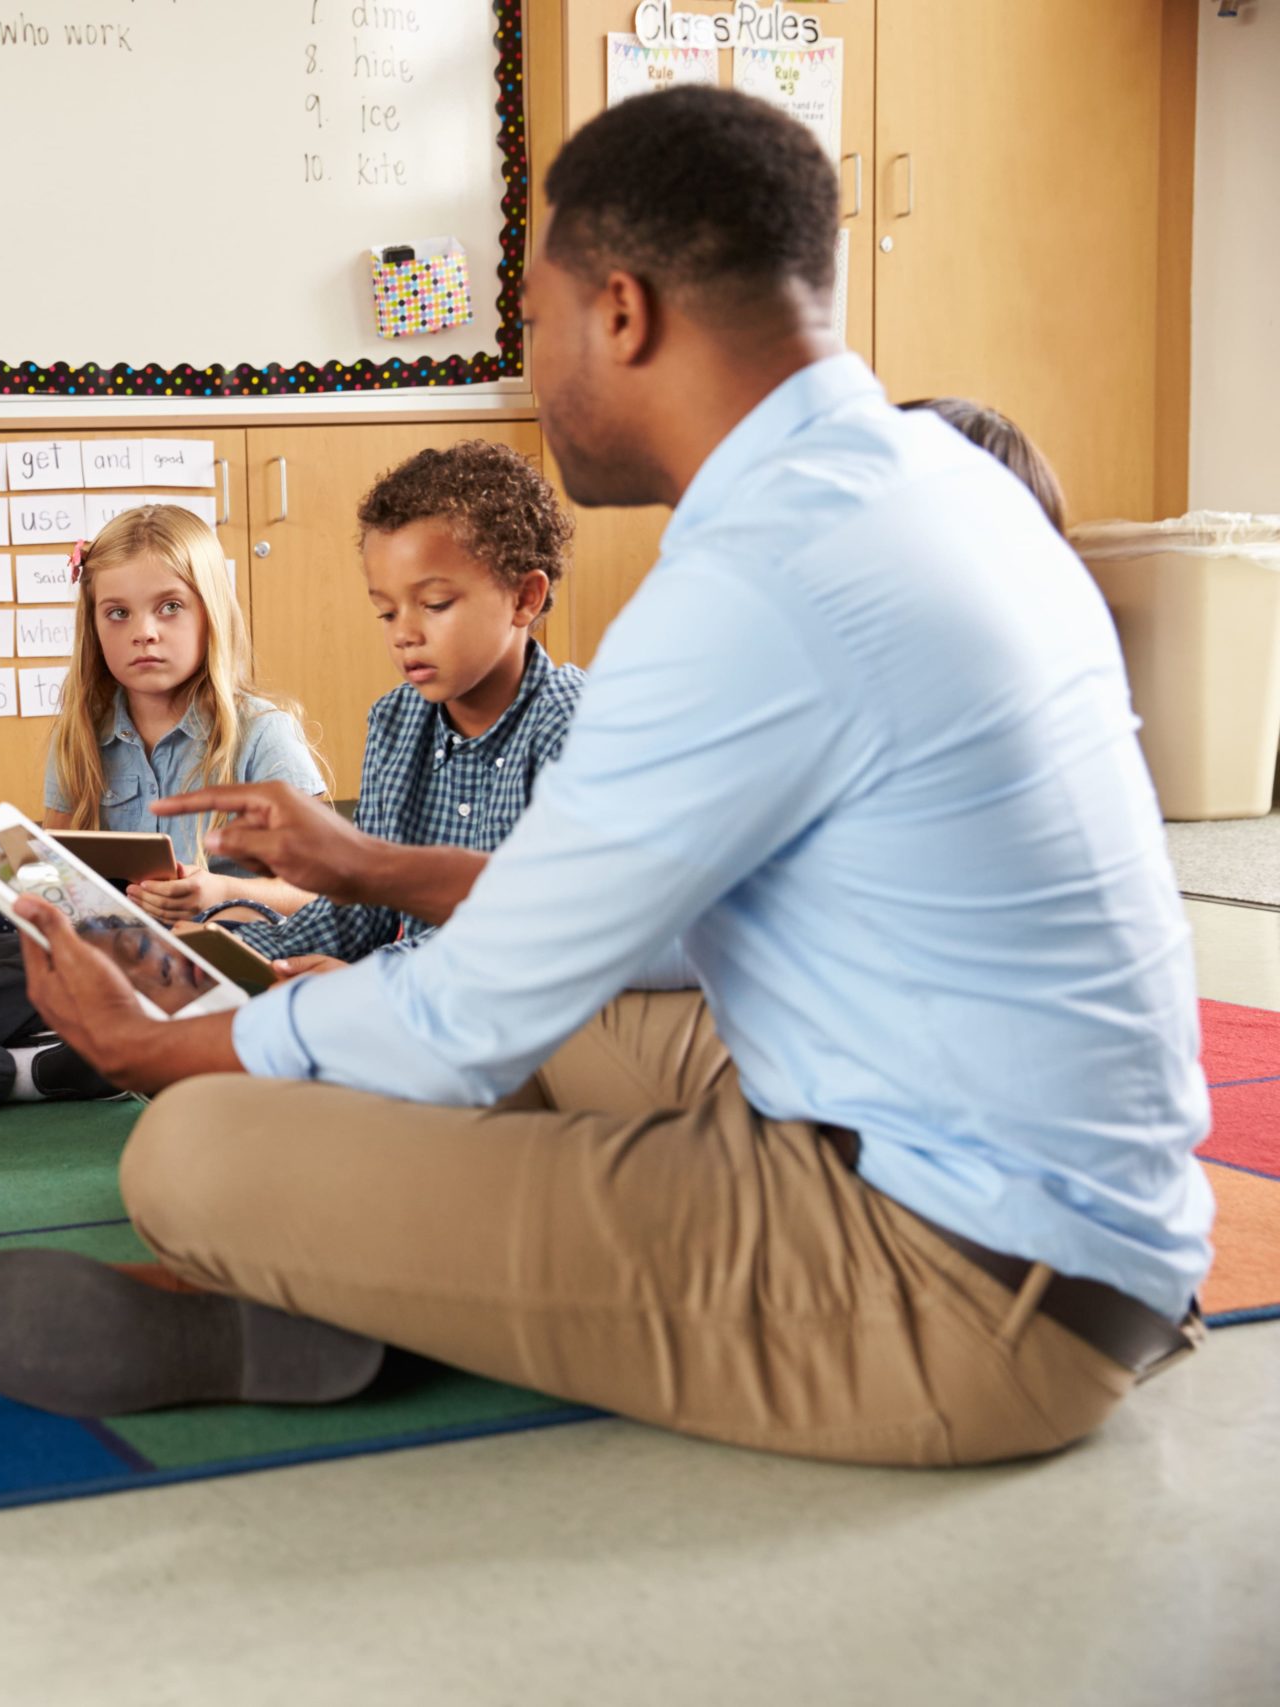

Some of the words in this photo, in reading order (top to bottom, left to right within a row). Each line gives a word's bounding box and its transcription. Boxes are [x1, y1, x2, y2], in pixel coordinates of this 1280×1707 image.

[738, 2, 819, 44] Rules
[352, 36, 415, 84] hide
[648, 65, 675, 81] Rule
[775, 65, 801, 81] Rule
[361, 95, 401, 134] ice
[22, 443, 62, 479] get
[94, 446, 131, 470] and
[153, 451, 184, 469] good
[21, 509, 71, 532] use
[33, 569, 68, 585] said
